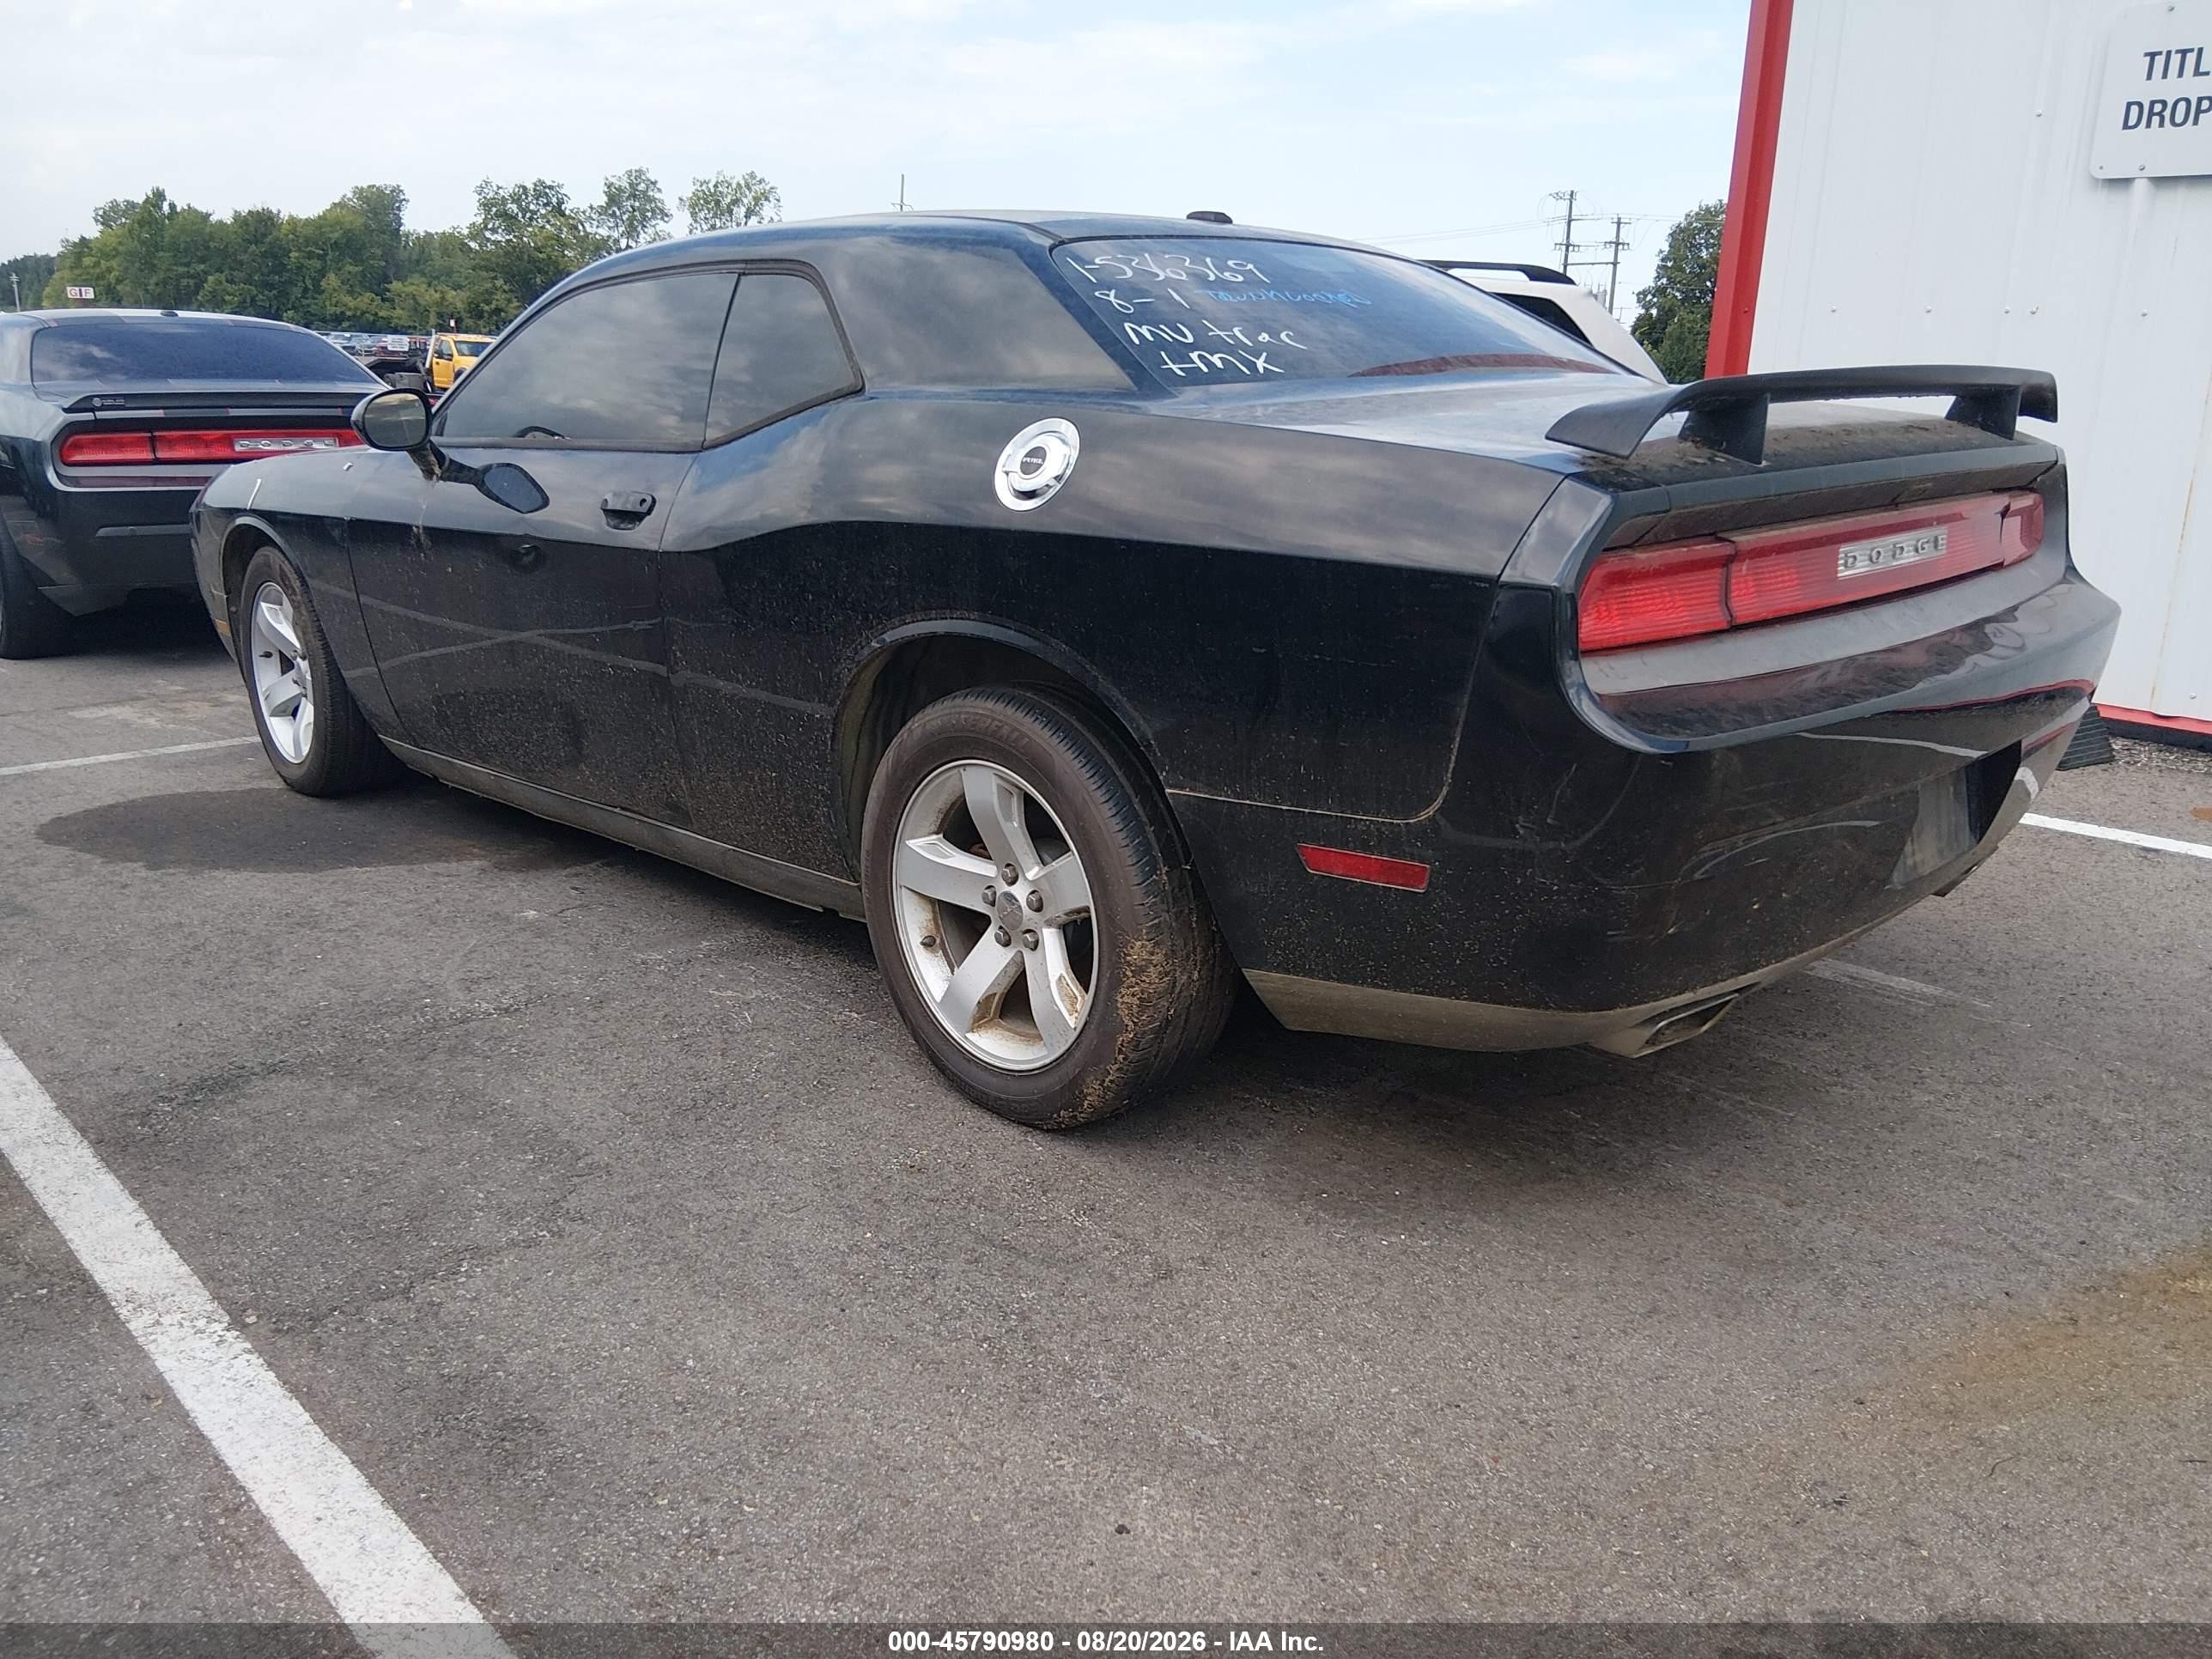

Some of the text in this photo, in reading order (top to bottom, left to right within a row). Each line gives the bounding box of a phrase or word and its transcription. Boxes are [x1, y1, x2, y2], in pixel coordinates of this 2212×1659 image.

[2142, 46, 2212, 81] TITL
[2121, 95, 2212, 131] DROP
[1844, 534, 1948, 568] DODGE
